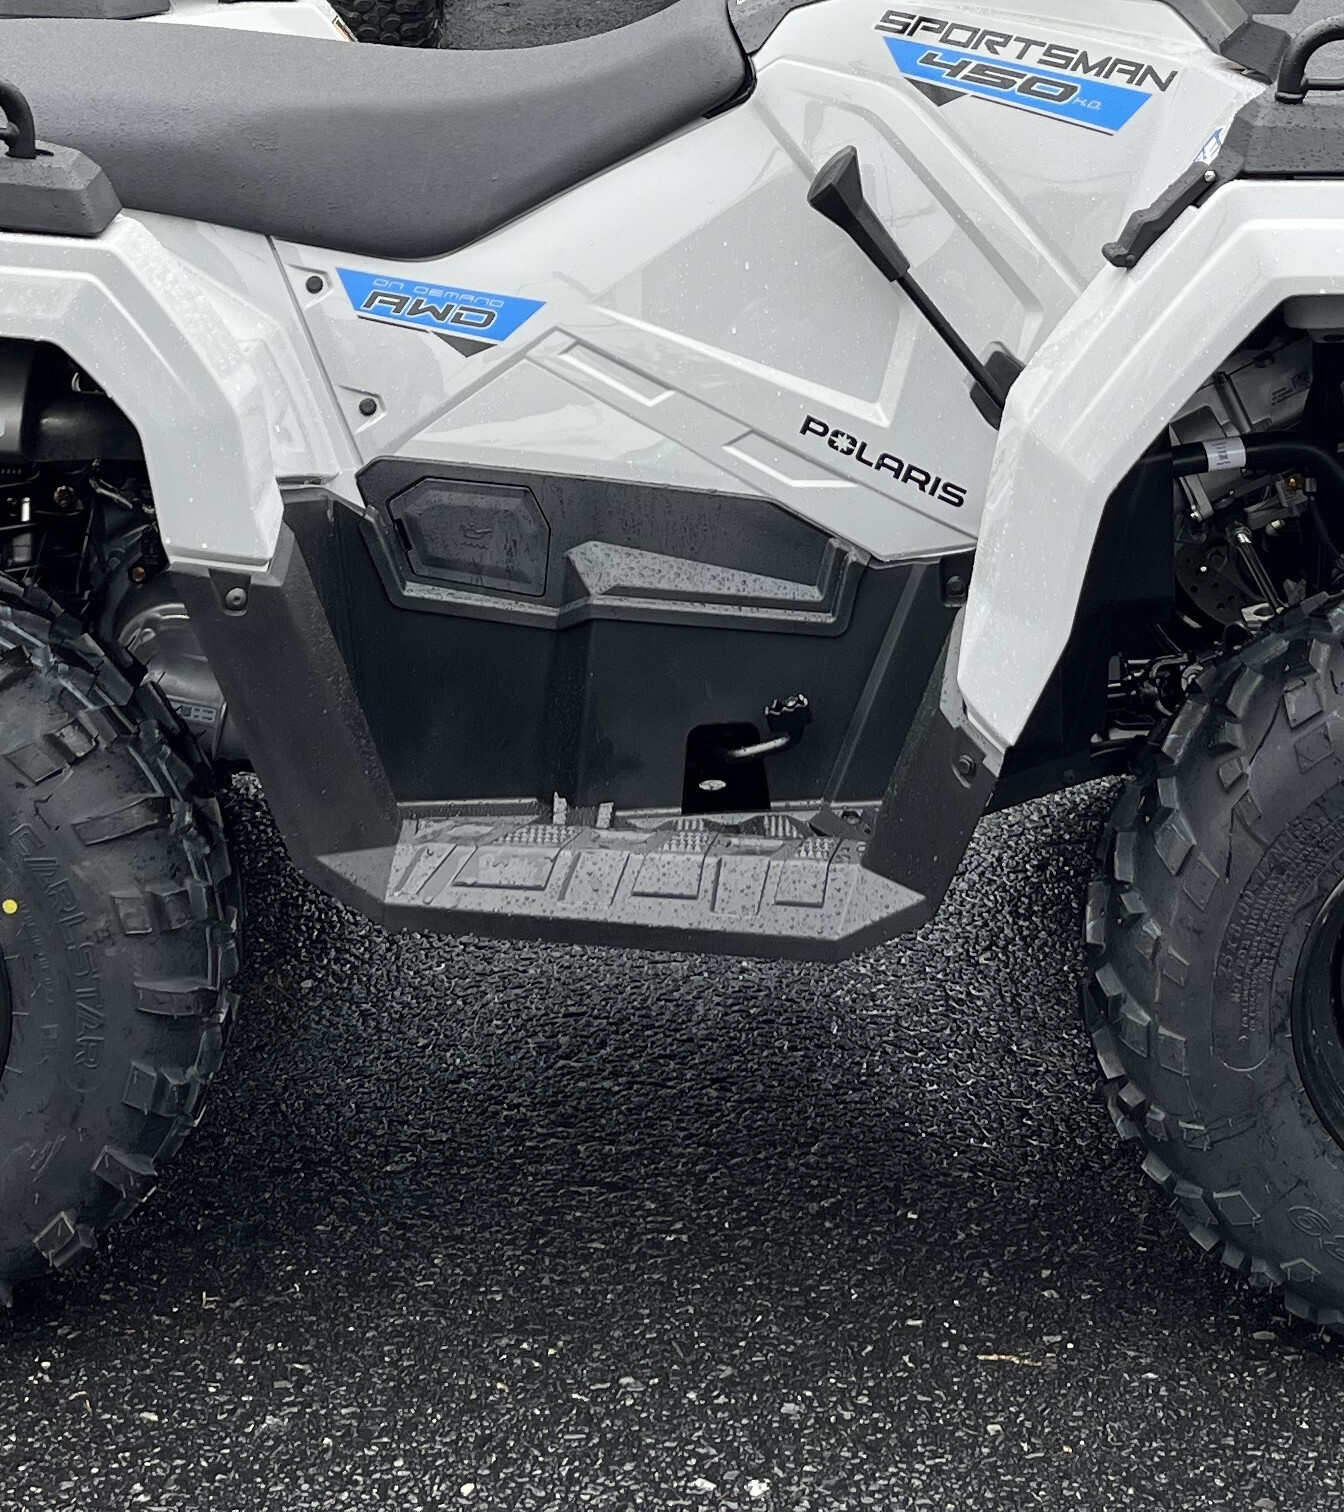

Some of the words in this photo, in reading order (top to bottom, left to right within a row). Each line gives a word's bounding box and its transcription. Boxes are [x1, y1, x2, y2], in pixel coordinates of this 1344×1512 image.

[874, 9, 1179, 92] SPORTSMAN
[917, 50, 1081, 105] 450
[360, 289, 498, 331] AWD
[372, 277, 406, 291] ON
[413, 284, 505, 309] DEMAND
[799, 414, 968, 508] POLARIS
